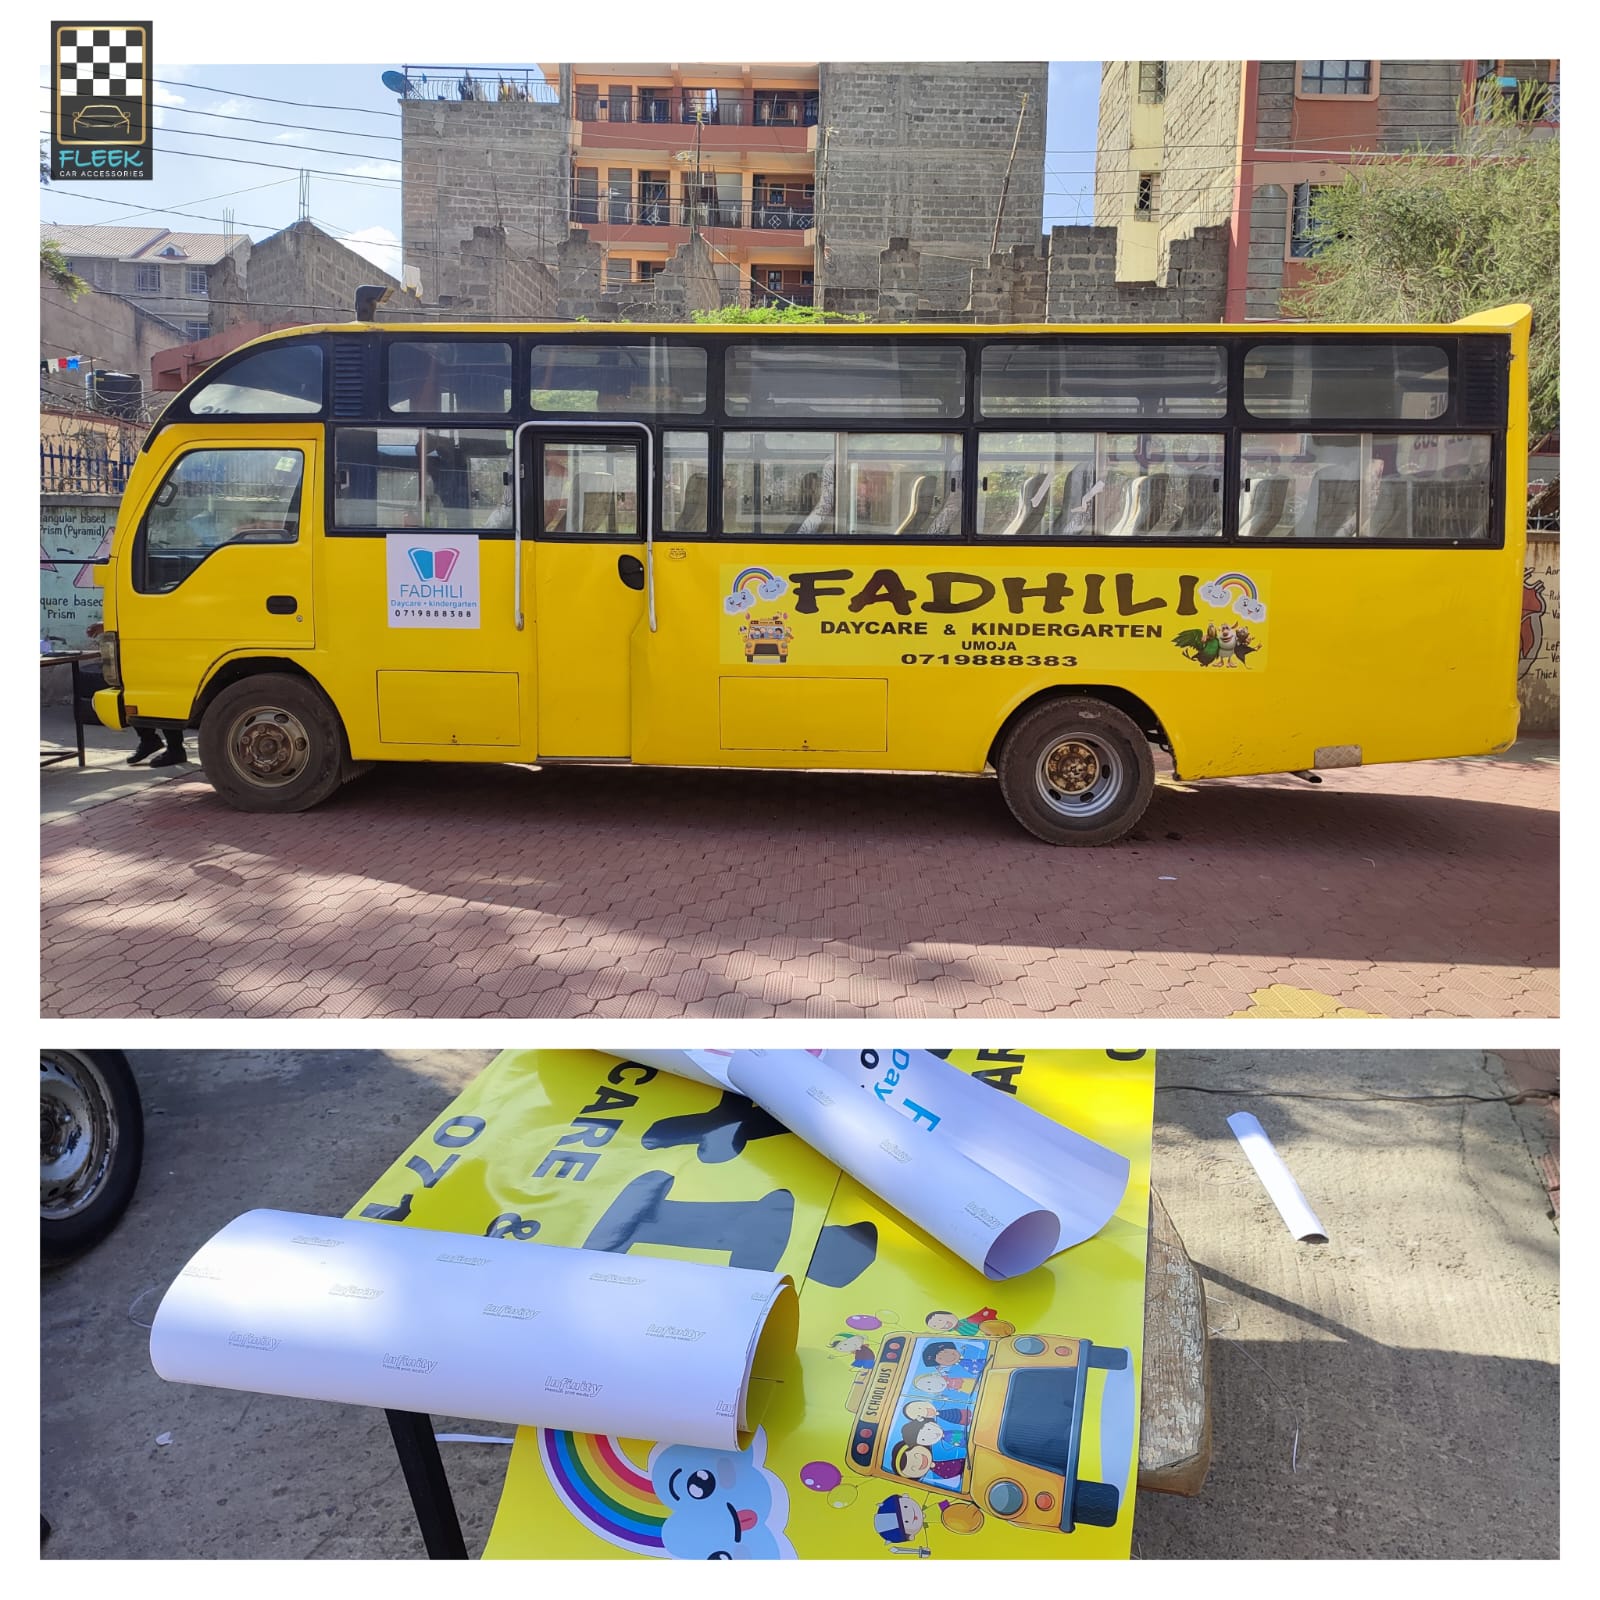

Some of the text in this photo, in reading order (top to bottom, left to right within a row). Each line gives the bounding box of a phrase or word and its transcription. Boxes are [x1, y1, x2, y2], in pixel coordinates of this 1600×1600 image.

[81, 511, 105, 524] based
[400, 584, 463, 598] FADHILI
[789, 569, 1199, 617] FADHILI
[47, 608, 76, 620] Prism
[820, 621, 1163, 638] DAYCARE & KINDERGARTEN
[961, 641, 1017, 651] UMOJA
[901, 653, 1078, 667] 0719888383
[531, 1061, 659, 1182] CARE
[544, 1375, 604, 1398] Infinity
[865, 1367, 892, 1417] SCHOOL BUS
